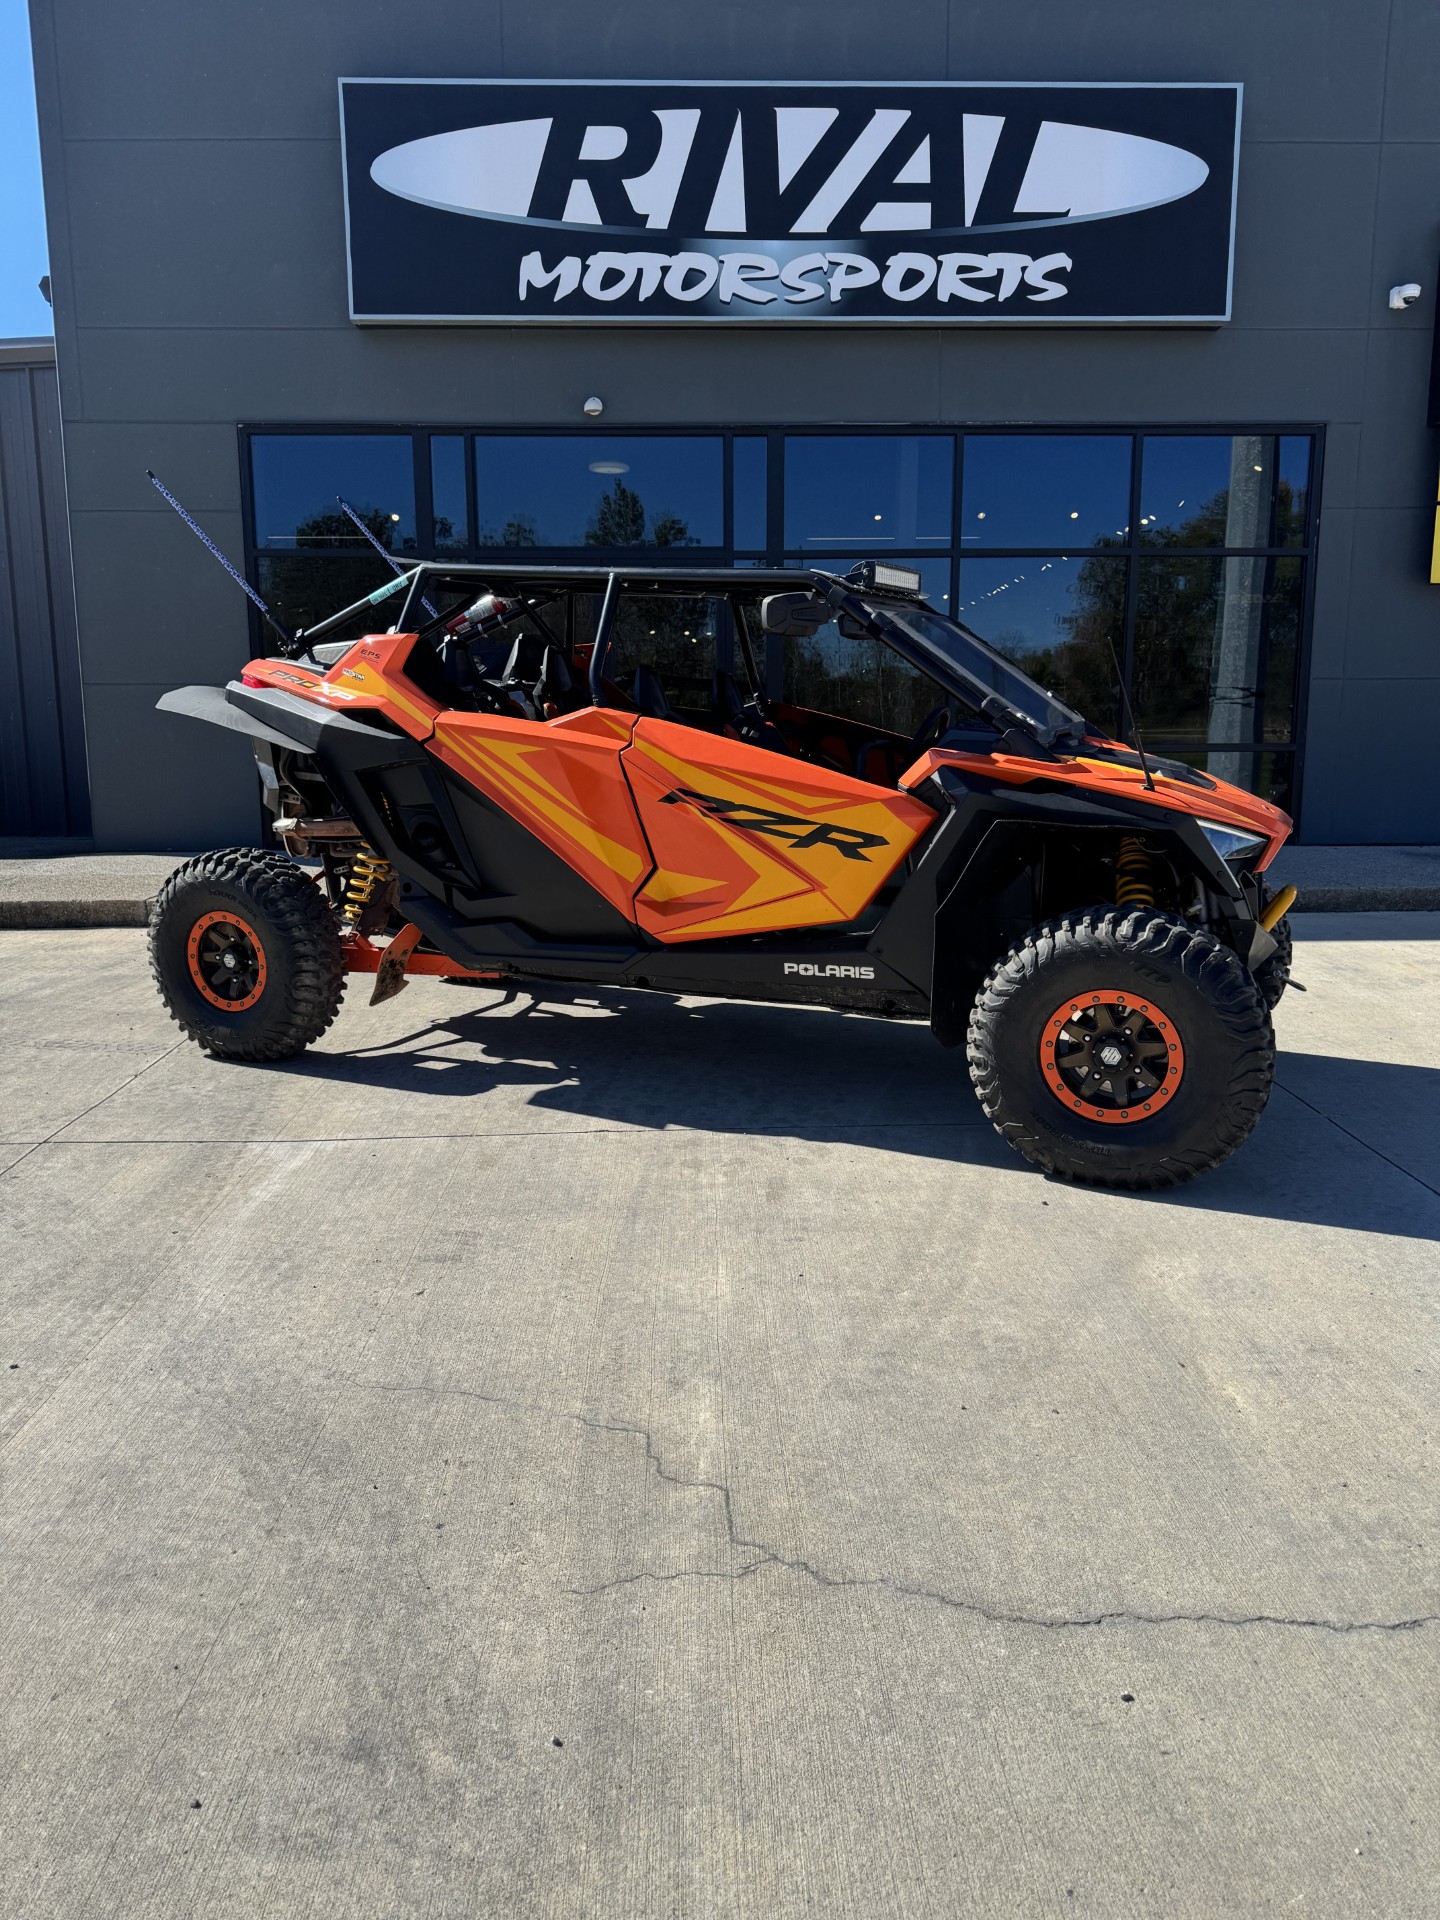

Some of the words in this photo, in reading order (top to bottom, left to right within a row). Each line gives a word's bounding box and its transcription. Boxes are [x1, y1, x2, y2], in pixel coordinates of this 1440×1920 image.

[526, 107, 1073, 235] RIVAL
[518, 251, 1074, 305] MOTORSPORTS
[360, 648, 382, 660] EPS
[268, 669, 318, 689] PRO
[657, 787, 890, 863] RZR
[783, 962, 875, 980] POLARIS
